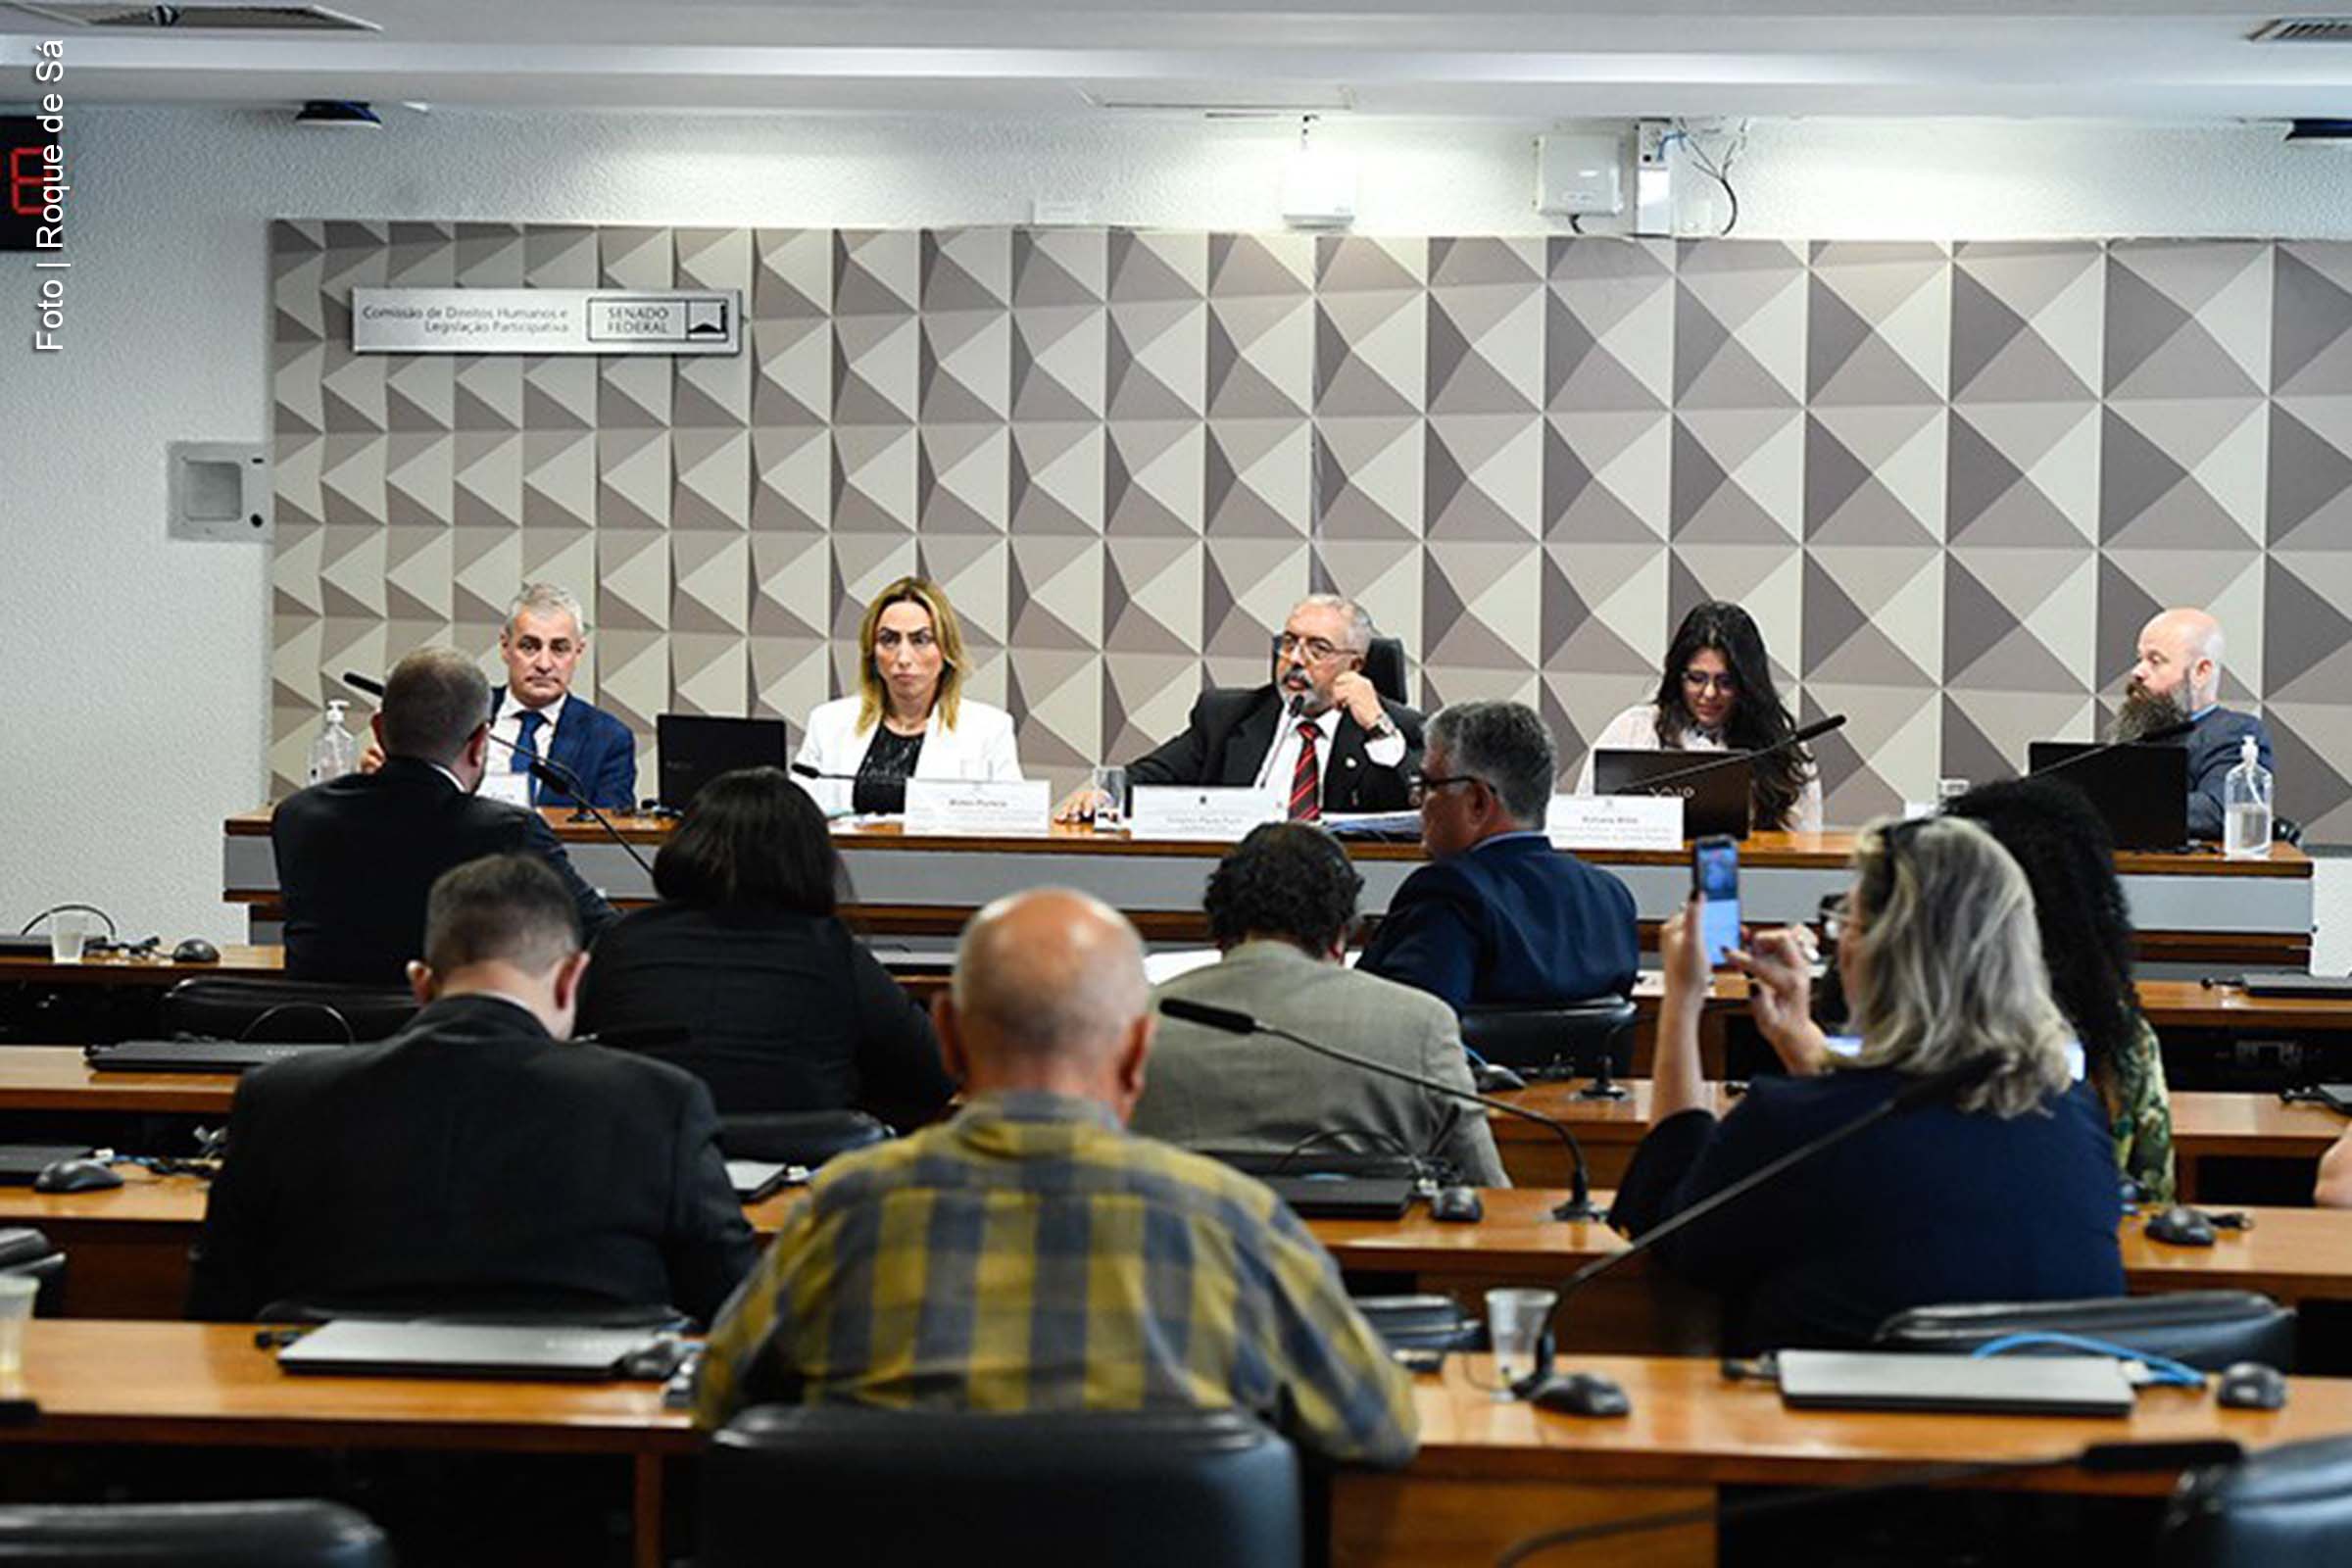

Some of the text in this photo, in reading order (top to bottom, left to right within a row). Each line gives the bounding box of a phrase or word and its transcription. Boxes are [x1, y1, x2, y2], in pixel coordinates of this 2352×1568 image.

[362, 305, 425, 319] Comissão
[426, 305, 443, 319] de
[446, 305, 493, 319] Direitos
[496, 306, 554, 319] Humanos
[608, 306, 669, 319] SENADO
[424, 319, 568, 335] Legislação Participativa
[608, 320, 668, 334] FEDERAL
